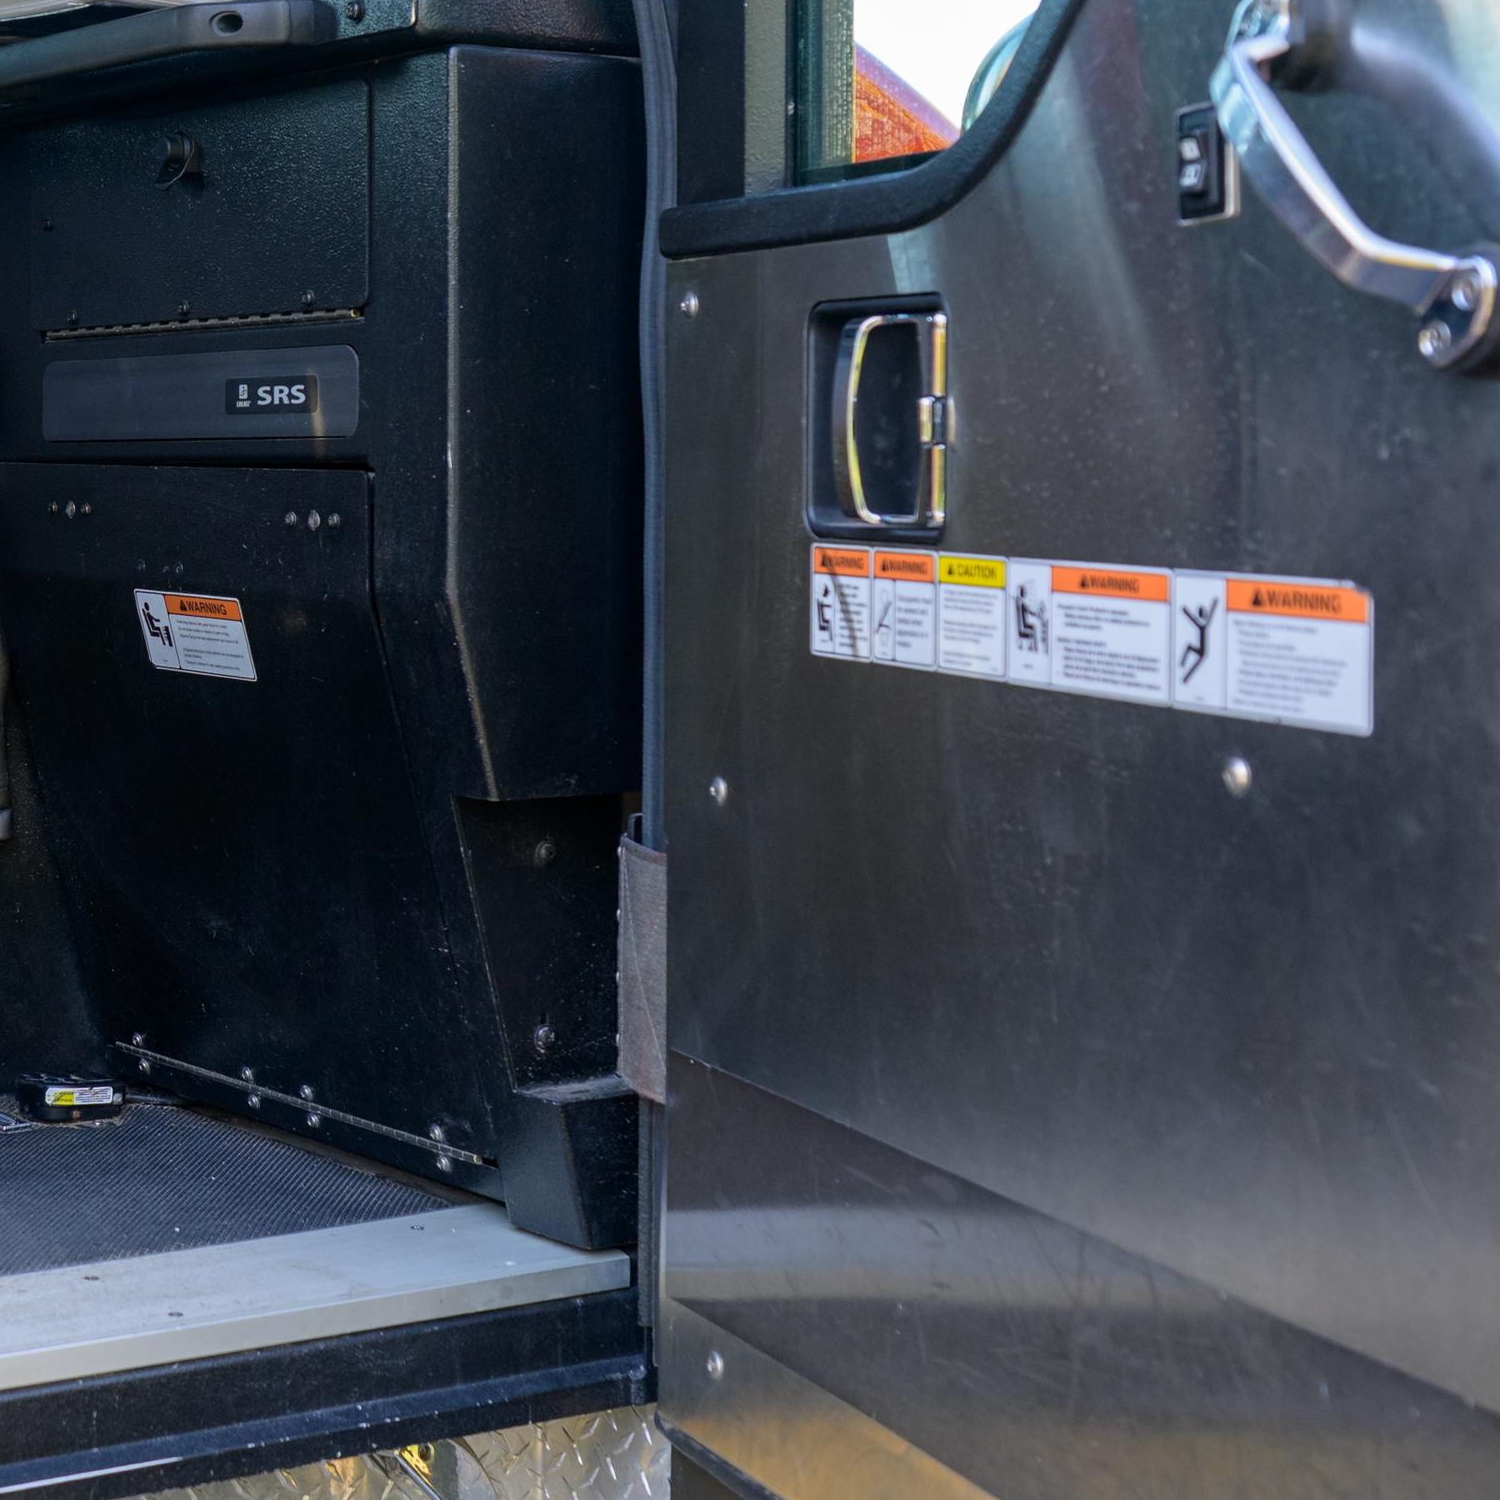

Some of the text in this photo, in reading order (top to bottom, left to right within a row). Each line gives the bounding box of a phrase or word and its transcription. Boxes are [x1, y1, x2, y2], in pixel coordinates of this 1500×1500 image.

[257, 384, 306, 405] SRS
[888, 560, 927, 575] WARNING
[957, 564, 998, 580] CAUTION
[1090, 576, 1140, 593] WARNING
[186, 601, 227, 615] WARNING
[1266, 589, 1342, 614] WARNING
